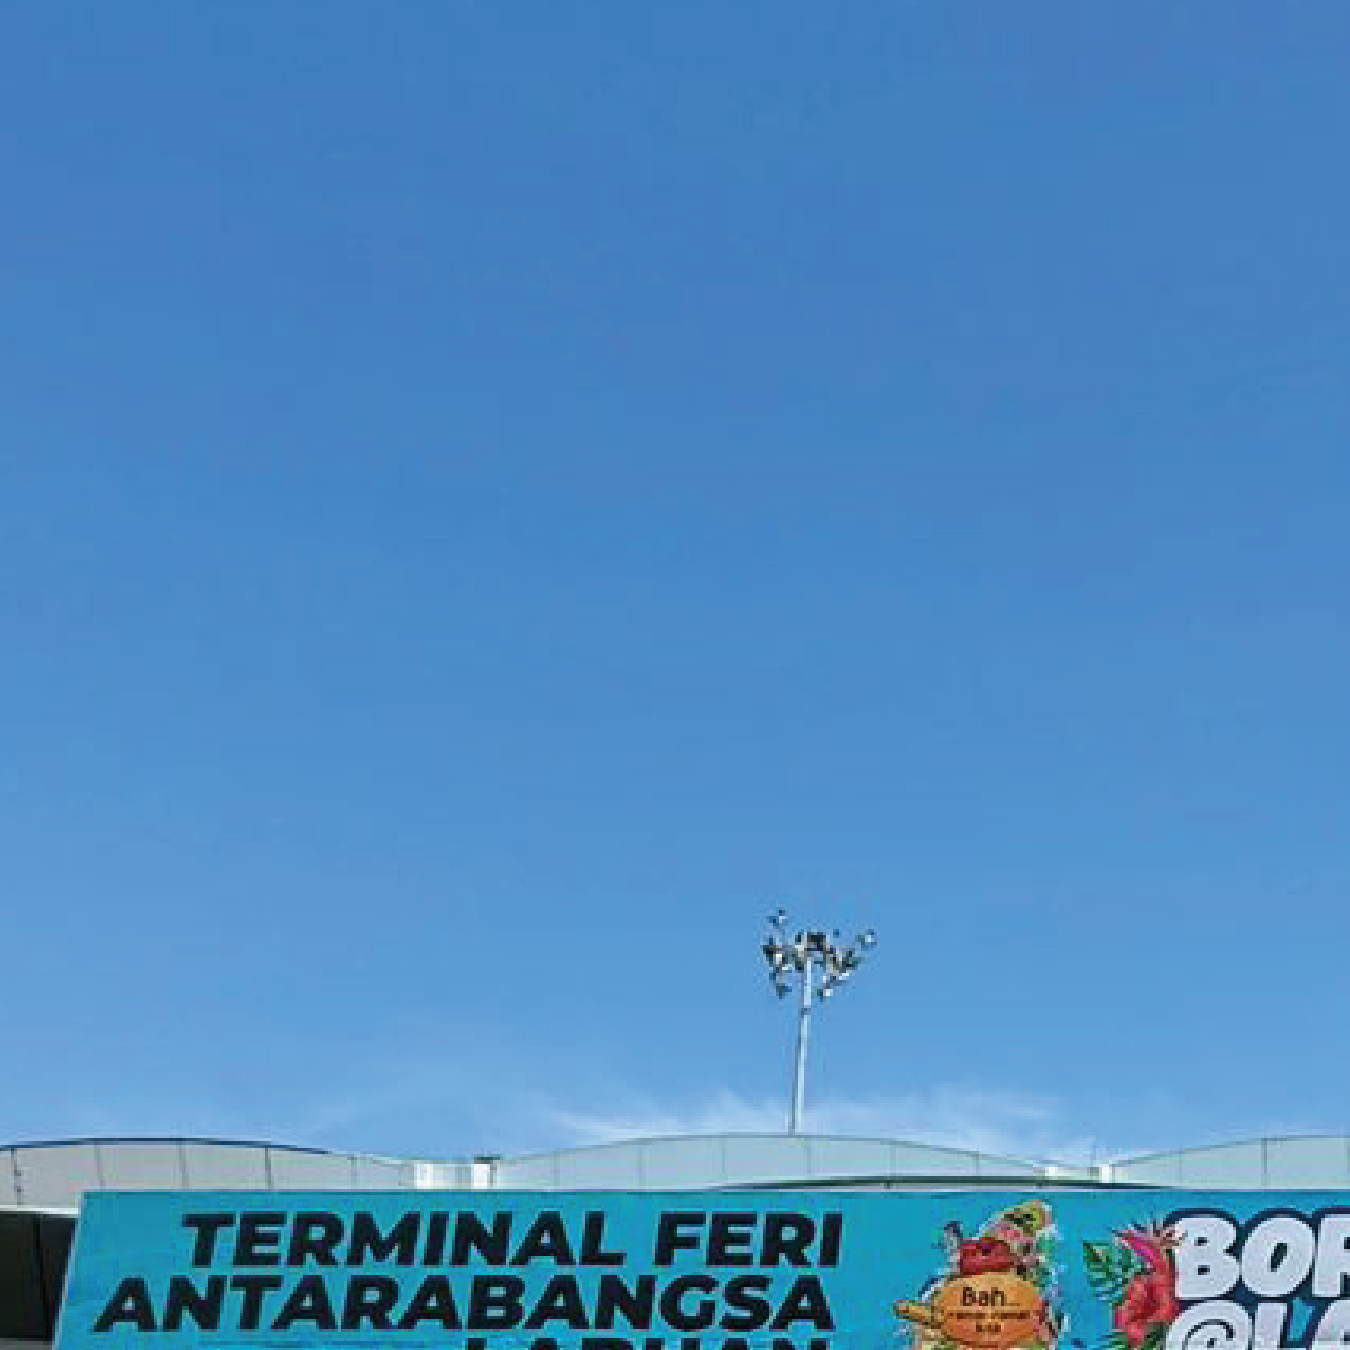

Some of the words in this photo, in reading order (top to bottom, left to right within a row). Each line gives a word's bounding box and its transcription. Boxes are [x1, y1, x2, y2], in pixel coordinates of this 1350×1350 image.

[181, 1210, 626, 1267] TERMINAL
[654, 1210, 843, 1268] FERI
[93, 1273, 835, 1332] ANTARABANGSA
